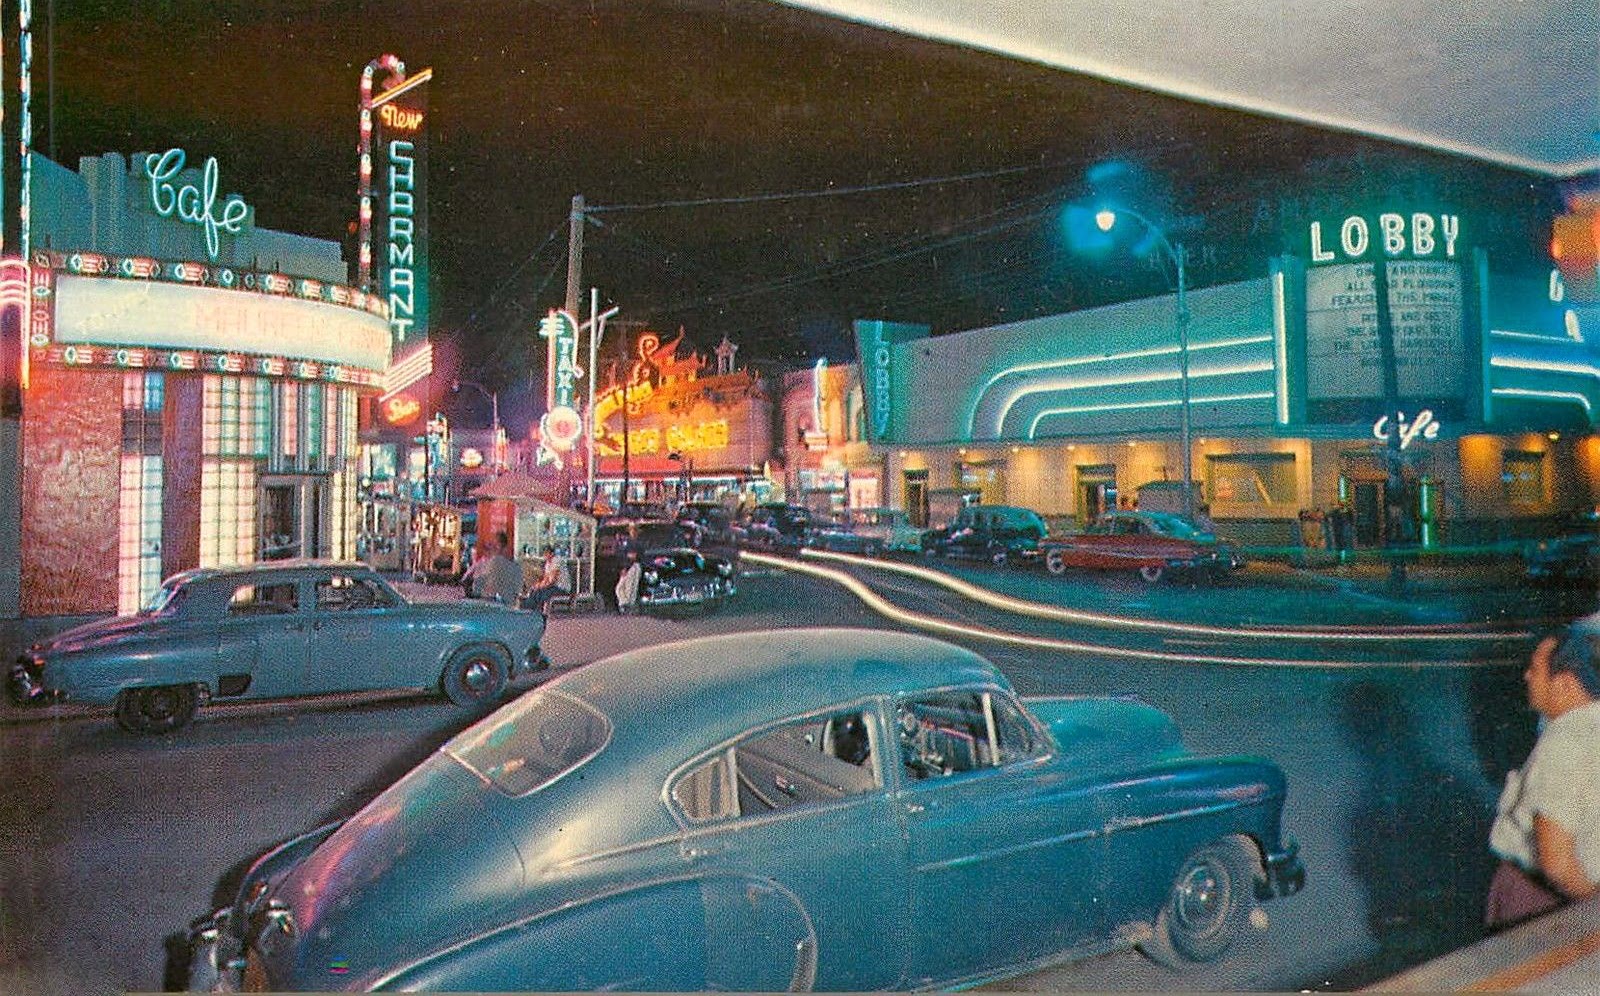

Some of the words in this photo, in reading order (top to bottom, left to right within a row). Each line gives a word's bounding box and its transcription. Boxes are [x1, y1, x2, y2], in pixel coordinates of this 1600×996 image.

[381, 104, 423, 130] New
[146, 147, 249, 259] Cafe
[1310, 212, 1459, 262] LOBBY
